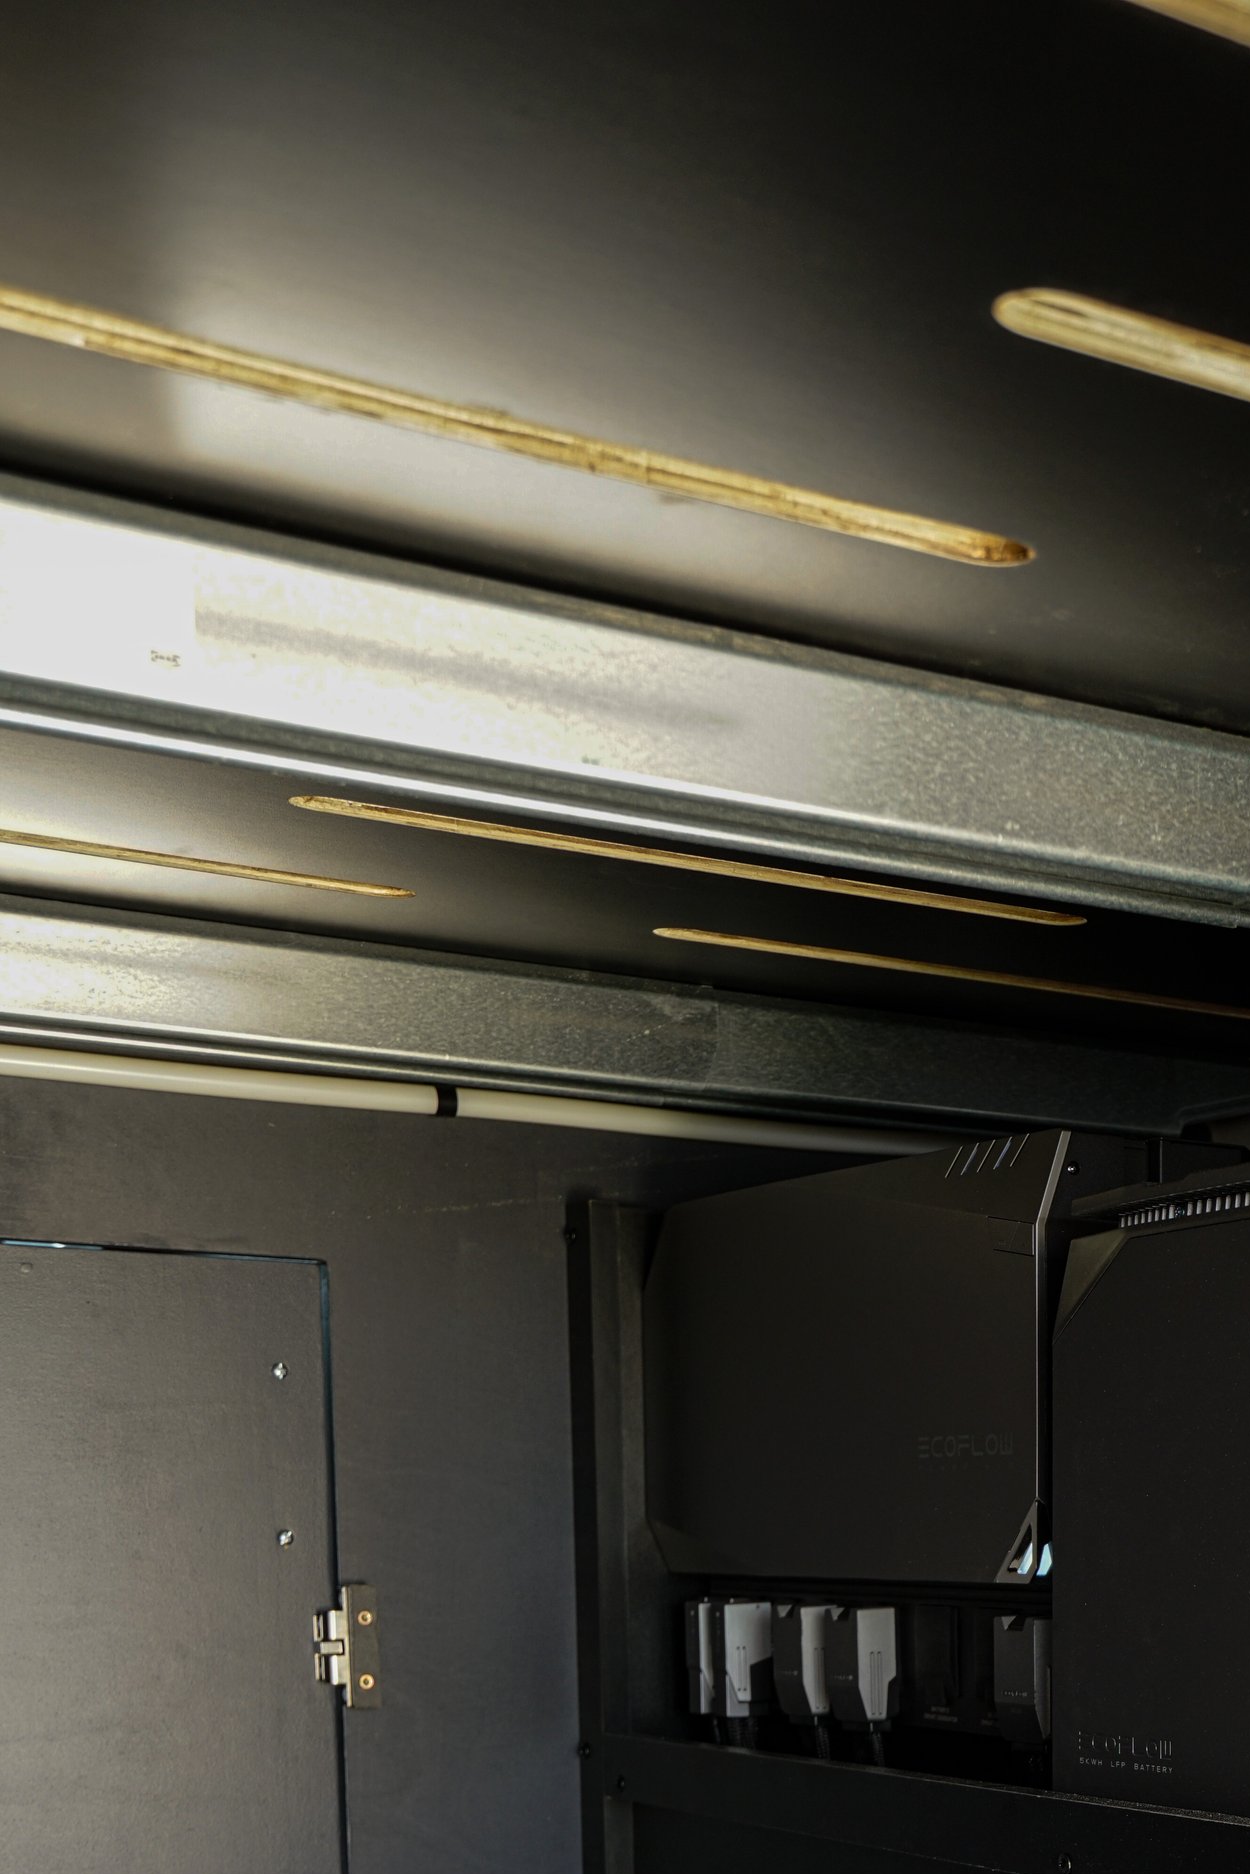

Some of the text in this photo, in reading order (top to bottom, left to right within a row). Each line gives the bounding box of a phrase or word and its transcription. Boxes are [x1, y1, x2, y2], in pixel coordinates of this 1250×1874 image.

[917, 1432, 1014, 1458] ECOFLOW
[1110, 1760, 1126, 1768] LFP
[1133, 1762, 1173, 1774] BATTERY
